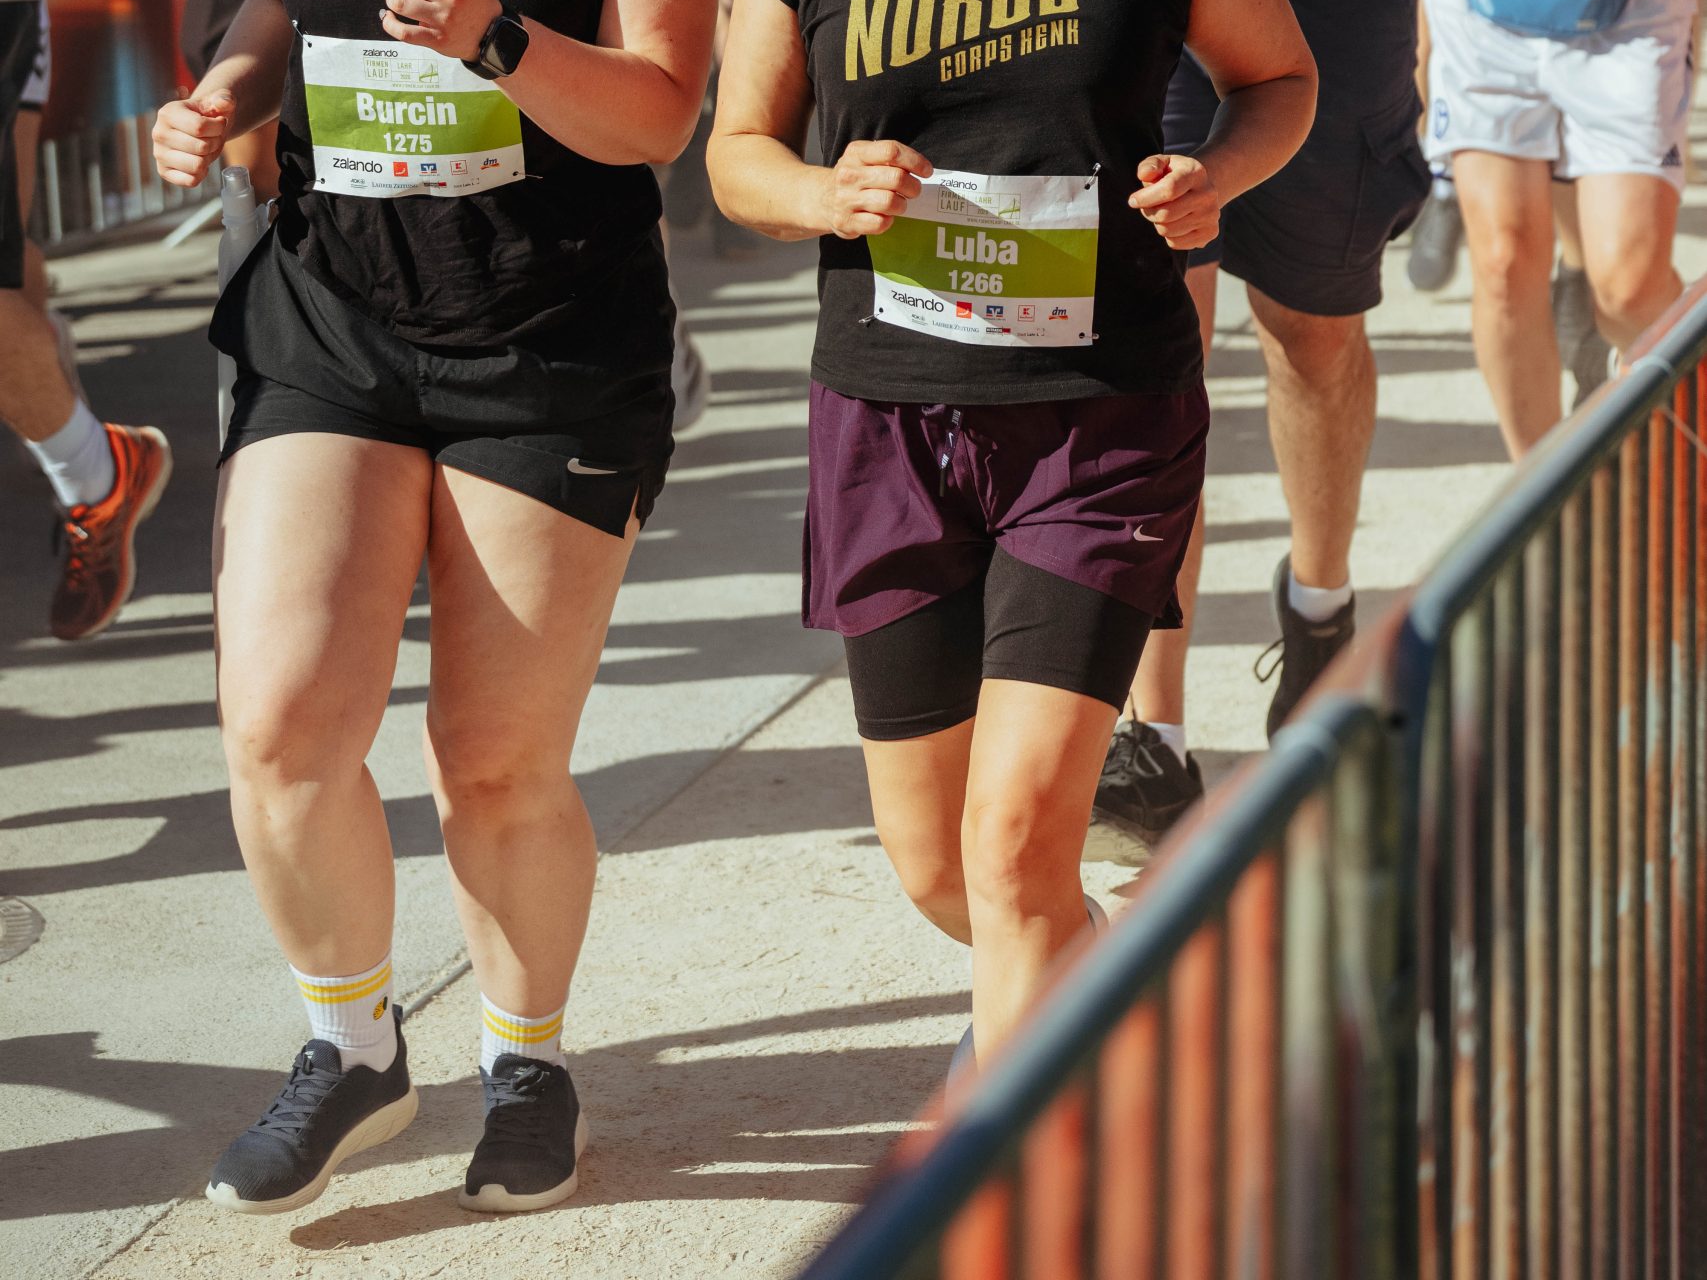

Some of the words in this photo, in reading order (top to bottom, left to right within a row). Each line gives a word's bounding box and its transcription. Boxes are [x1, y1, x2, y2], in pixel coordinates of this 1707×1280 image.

[362, 49, 399, 58] zalando
[940, 34, 1012, 83] CORPS
[367, 68, 389, 78] LAUF
[356, 91, 458, 126] Burcin
[384, 132, 433, 153] 1275
[332, 157, 383, 174] zalando
[483, 158, 498, 166] dm
[940, 179, 978, 191] zalando
[940, 199, 966, 212] LAUF
[936, 226, 1019, 266] Luba
[948, 270, 1004, 295] 1266
[891, 290, 945, 313] zalando
[1052, 307, 1067, 316] dm
